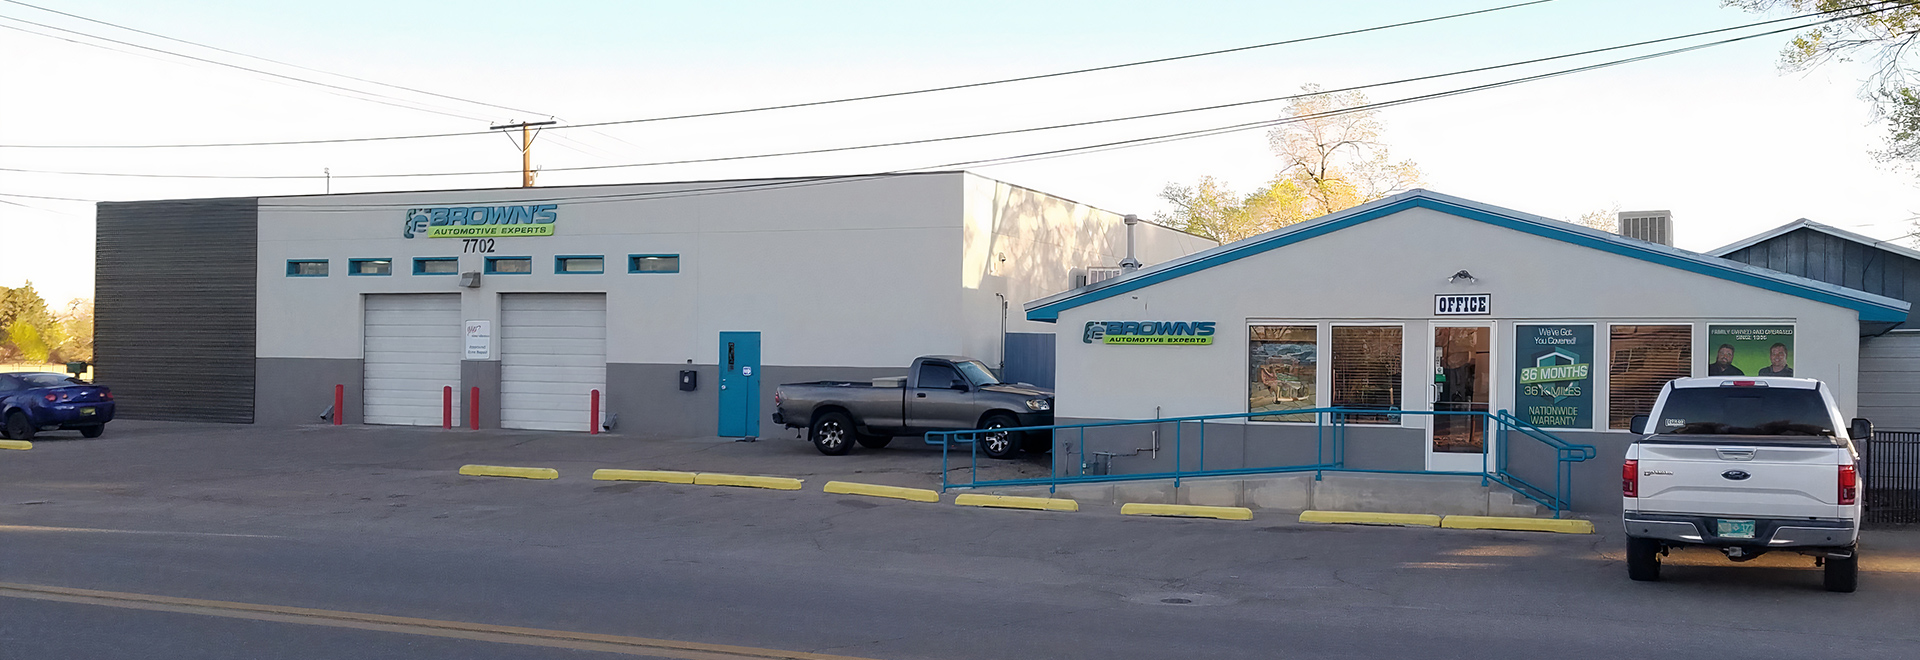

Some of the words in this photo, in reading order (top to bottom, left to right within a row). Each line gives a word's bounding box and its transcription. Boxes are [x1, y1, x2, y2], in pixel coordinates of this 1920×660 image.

[429, 204, 558, 226] BROWN'S
[433, 227, 497, 235] AUTOMOTIVE
[501, 226, 547, 234] EXPERTS
[462, 238, 495, 253] 7702
[1439, 296, 1486, 312] OFFICE
[1105, 321, 1217, 336] BROWN'S
[1538, 327, 1560, 336] We've
[1560, 328, 1573, 336] Got
[1534, 336, 1547, 344] You
[1521, 368, 1538, 381] 36
[1540, 365, 1588, 380] MONTHS
[1524, 386, 1539, 396] 36
[1551, 386, 1582, 396] MILES
[1528, 406, 1579, 416] NATIONWIDE
[1530, 416, 1577, 425] WARRANTY
